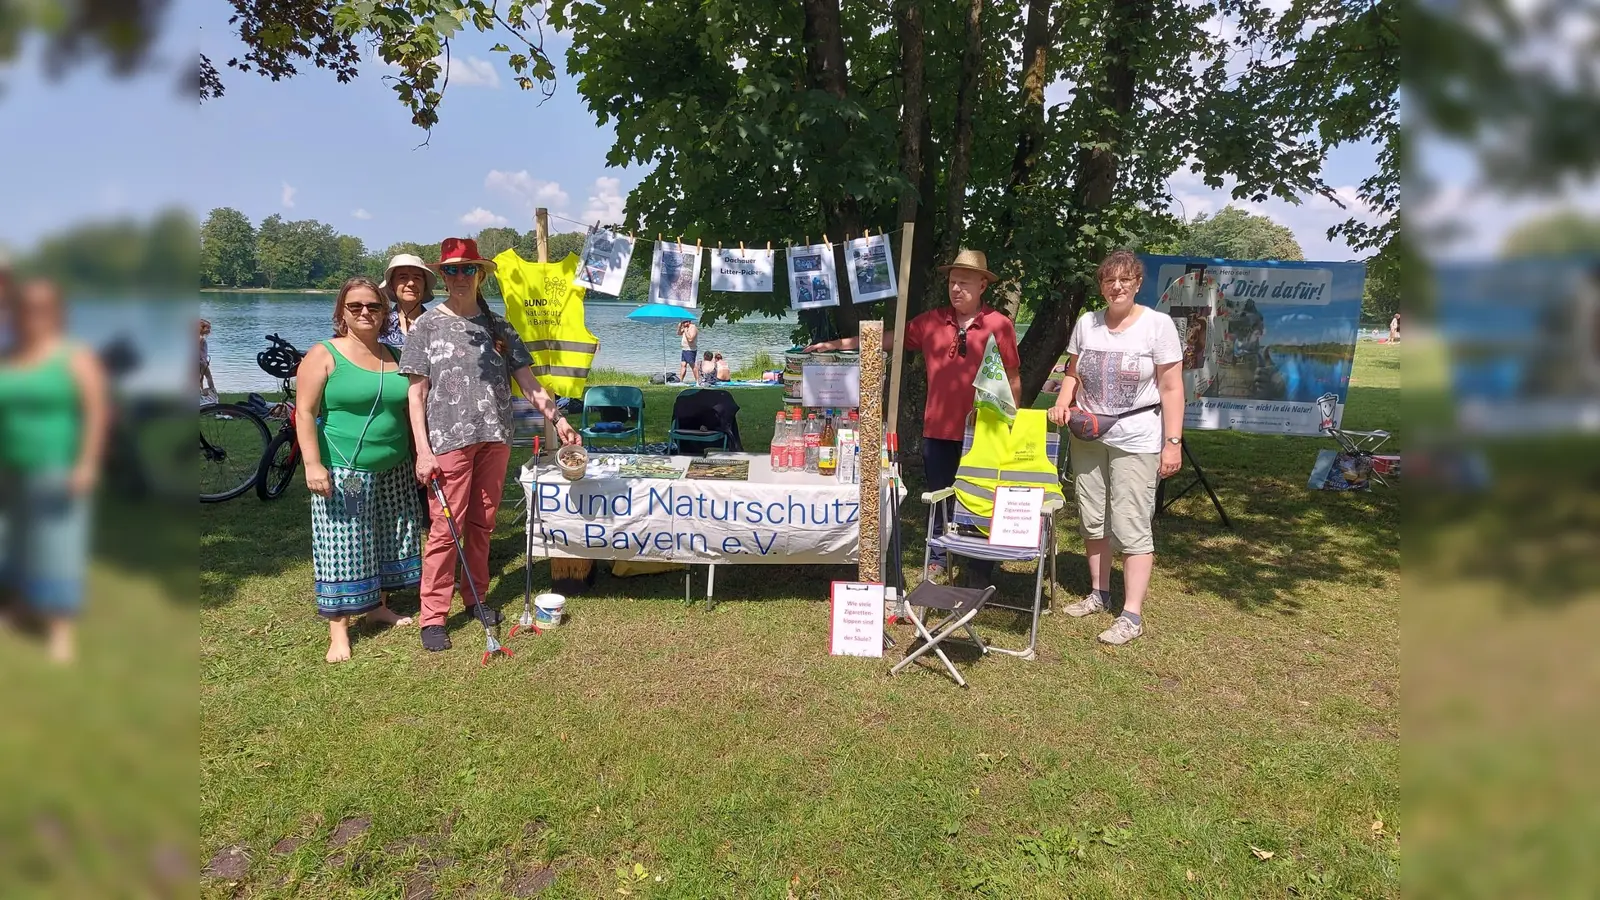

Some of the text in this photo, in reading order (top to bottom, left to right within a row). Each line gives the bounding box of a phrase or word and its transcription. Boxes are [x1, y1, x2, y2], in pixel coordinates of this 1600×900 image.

[724, 256, 756, 264] Dachauer
[1234, 280, 1268, 298] Dich
[1271, 280, 1326, 300] dafür!
[524, 298, 548, 307] BUND
[1256, 403, 1272, 412] nicht
[539, 483, 858, 524] Bund Naturschutz
[541, 524, 777, 555] in Bayern e.V.
